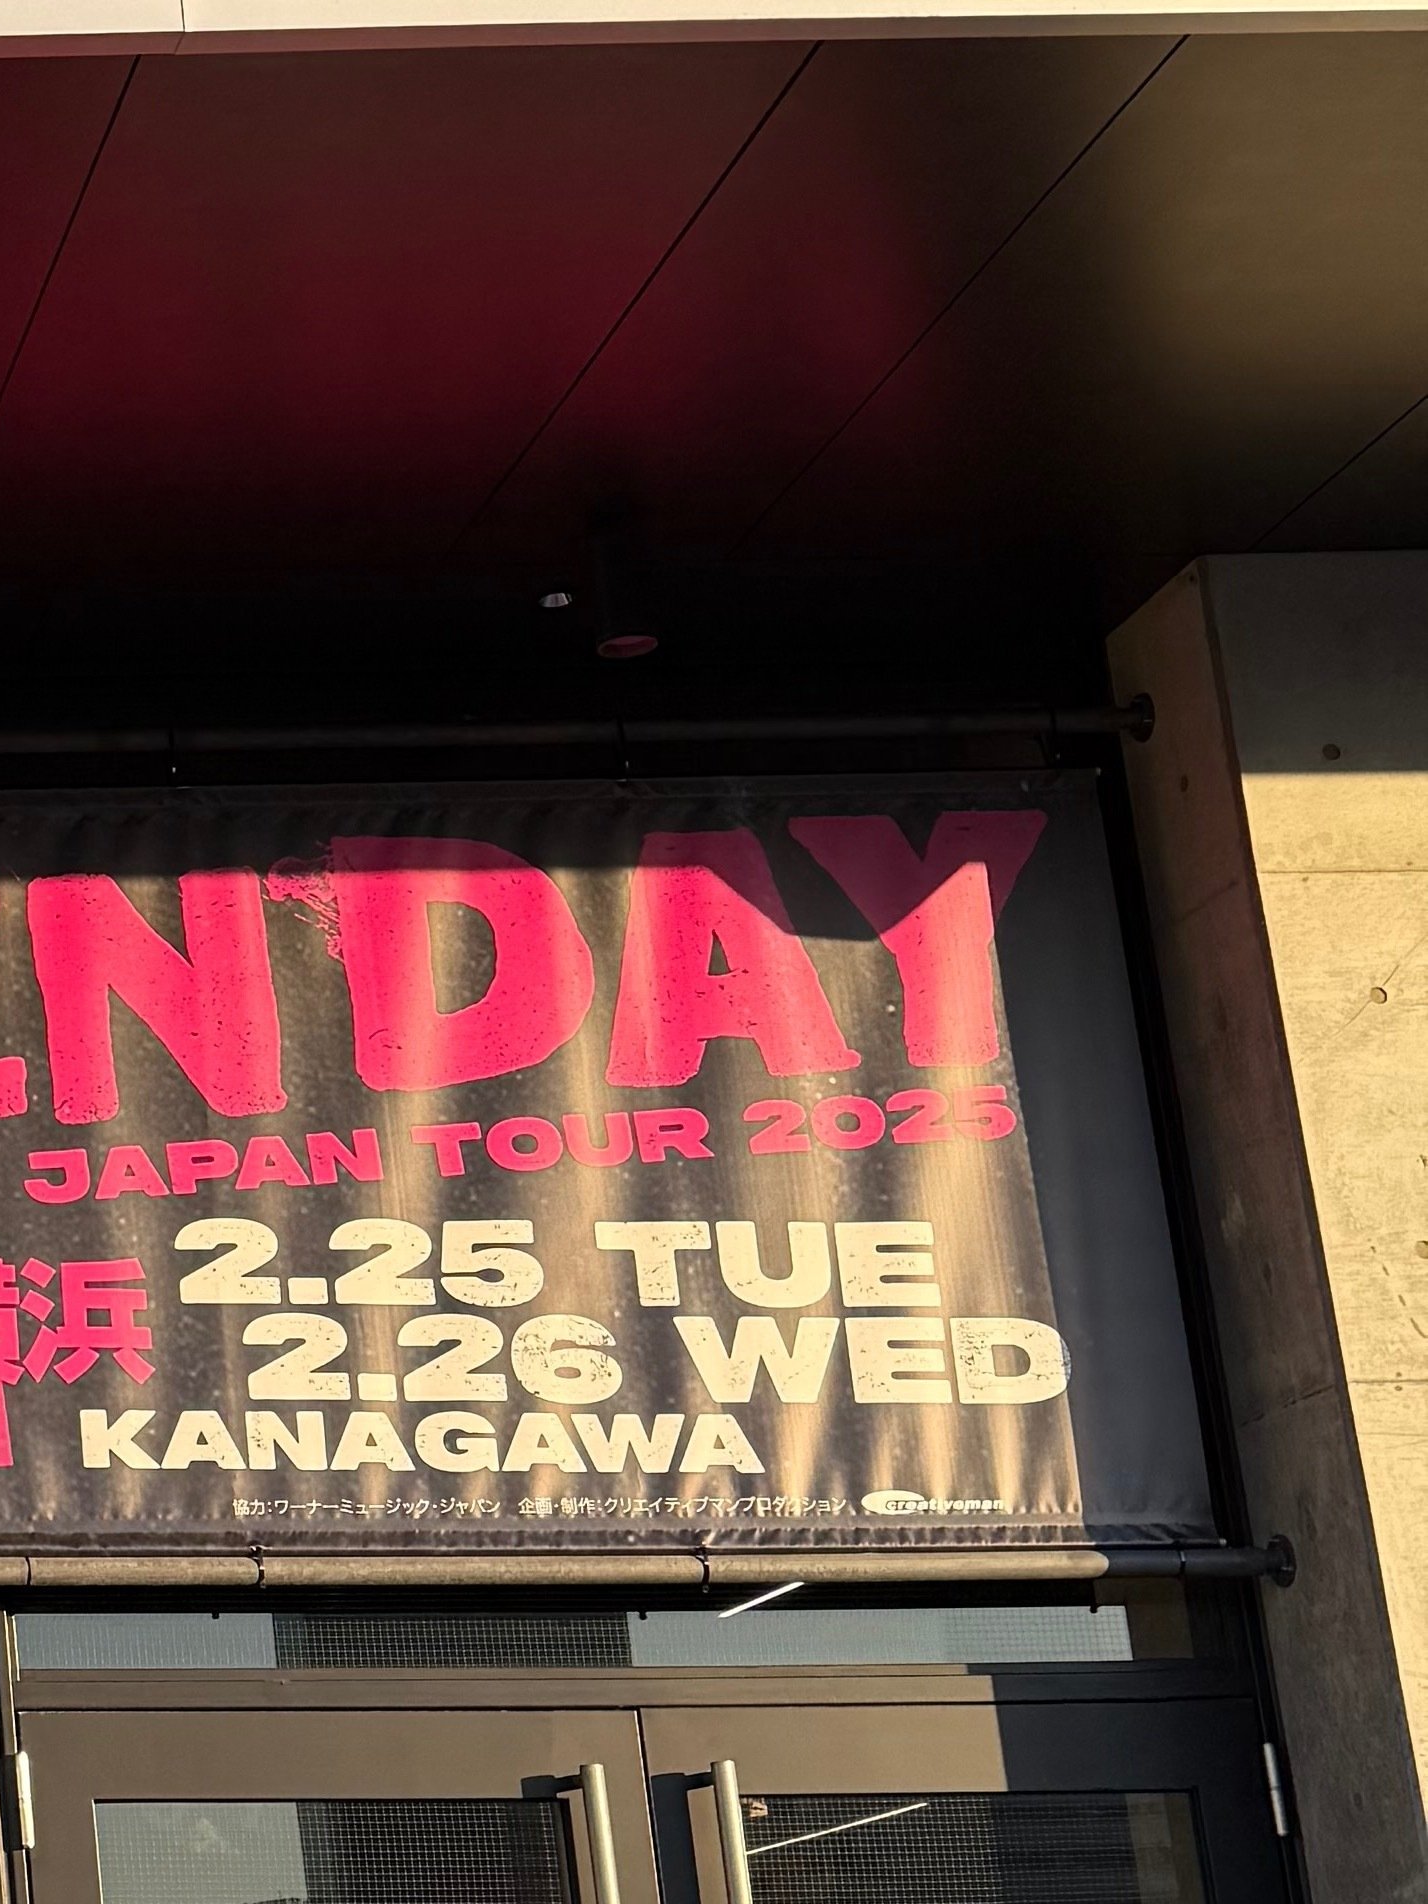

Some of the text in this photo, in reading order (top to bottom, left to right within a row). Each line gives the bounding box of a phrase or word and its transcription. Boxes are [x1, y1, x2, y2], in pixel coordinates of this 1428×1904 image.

[266, 810, 1048, 1092] DAY
[22, 1085, 1016, 1207] JAPAN TOUR 2025
[175, 1218, 937, 1309] 2.25 TUE
[243, 1312, 1070, 1406] 2.26 WED
[80, 1409, 766, 1474] KANAGAWA
